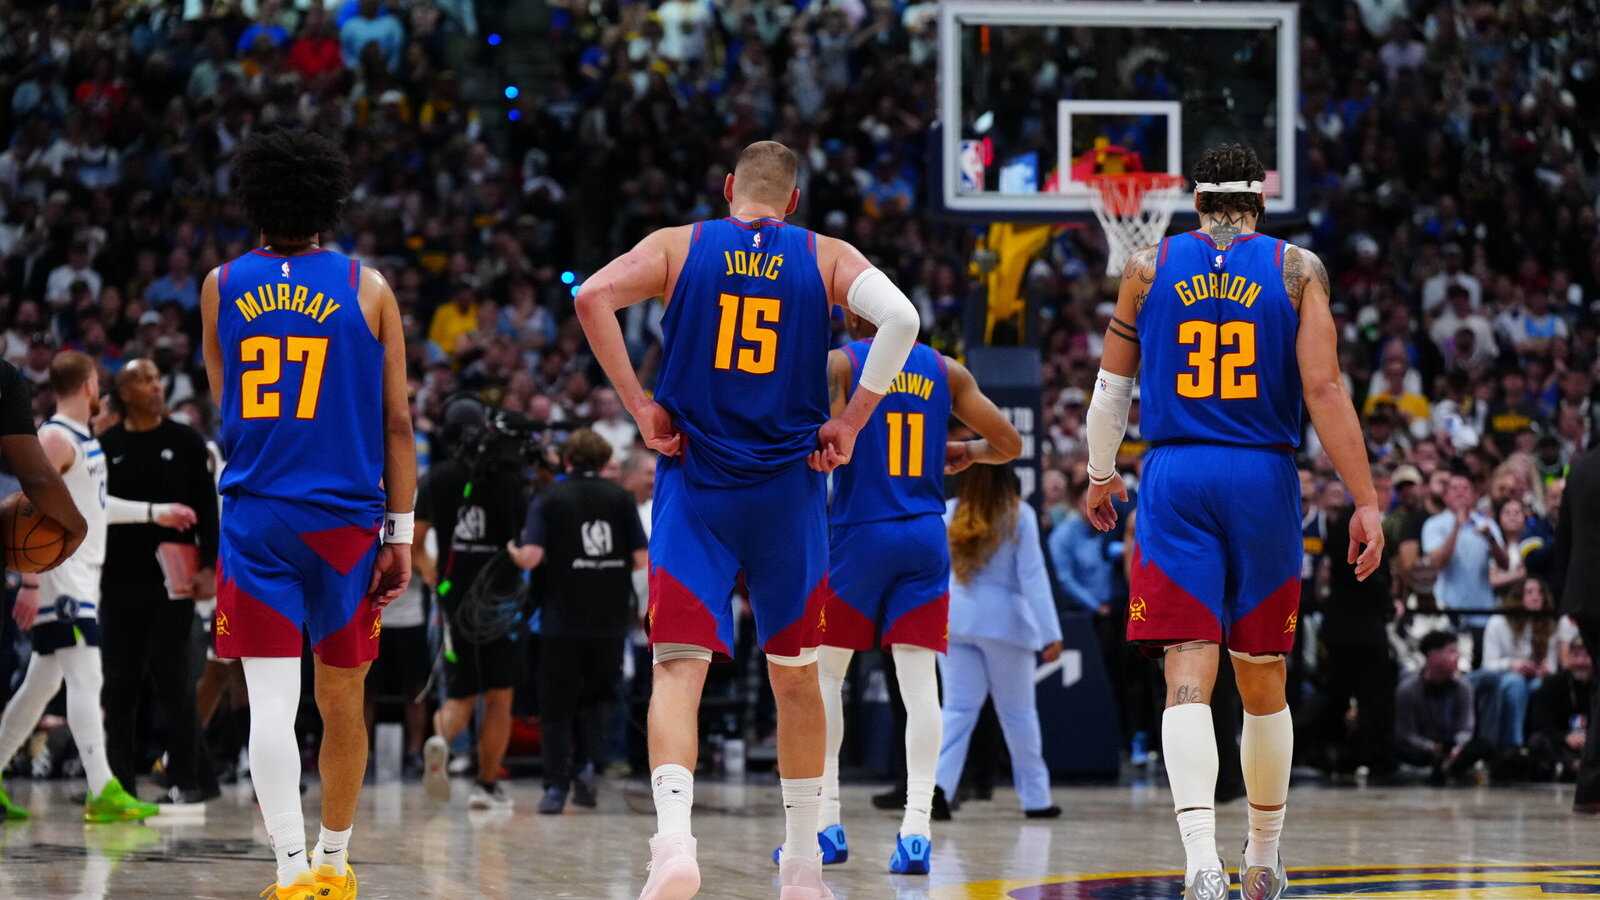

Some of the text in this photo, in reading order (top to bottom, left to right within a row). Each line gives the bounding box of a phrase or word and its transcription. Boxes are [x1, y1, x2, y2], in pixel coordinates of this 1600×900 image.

[235, 283, 341, 324] MURRAY
[1174, 272, 1262, 308] GORDON
[713, 292, 782, 375] 15
[1175, 319, 1259, 400] 32
[239, 334, 330, 421] 27
[886, 371, 934, 400] OWN
[886, 411, 925, 477] 11
